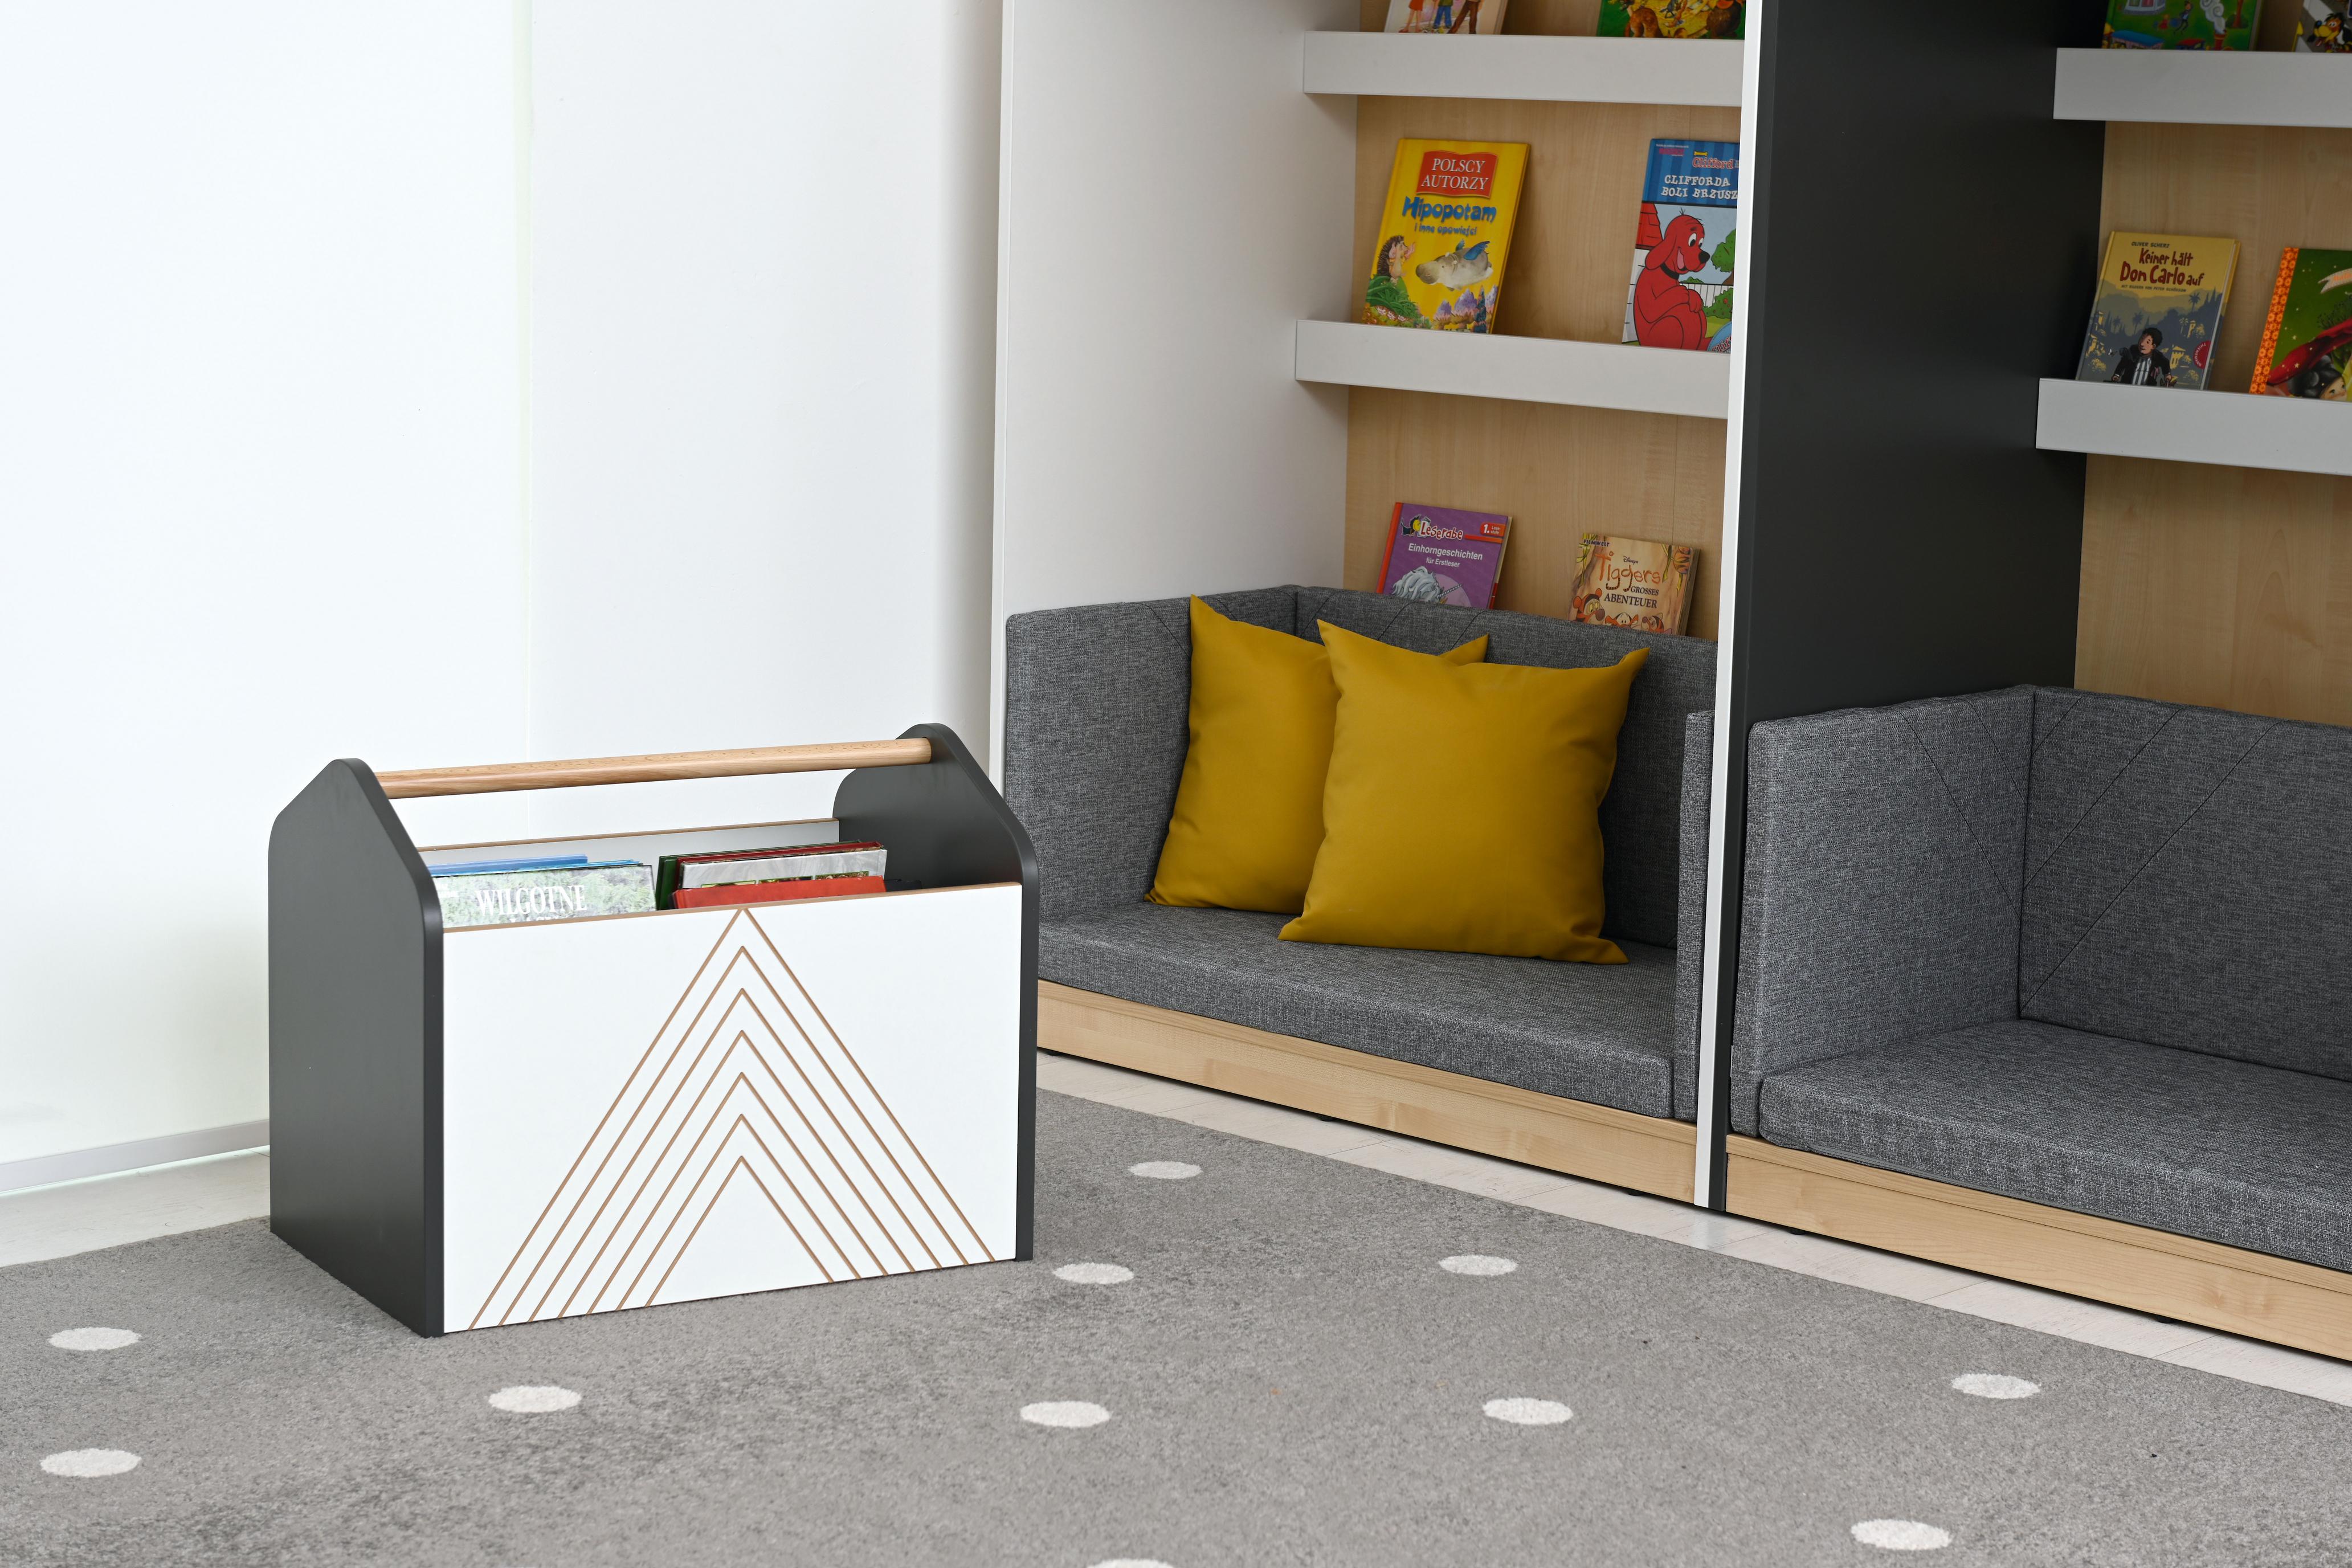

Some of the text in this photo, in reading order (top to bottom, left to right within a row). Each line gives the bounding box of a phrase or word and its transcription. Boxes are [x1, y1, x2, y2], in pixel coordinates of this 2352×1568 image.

[1432, 158, 1486, 173] POLSCY
[1692, 157, 1734, 169] Clifford
[1421, 174, 1489, 190] AUTORZY
[1664, 175, 1730, 187] CLIFFORDA
[1661, 186, 1688, 197] BOLI
[1402, 196, 1497, 223] Hipopotam
[2138, 248, 2194, 267] Keiner hält
[2120, 261, 2205, 286] Don Carlo auf
[1421, 521, 1463, 541] Leserabe
[1484, 524, 1490, 534] 1.
[1408, 543, 1483, 561] Einhorngeschichten
[1435, 558, 1460, 567] Erstleser
[1595, 551, 1661, 592] Tiggers
[1631, 586, 1659, 596] GROSSES
[1604, 593, 1657, 609] ABENTEUER
[475, 885, 587, 917] WILGOTNE
